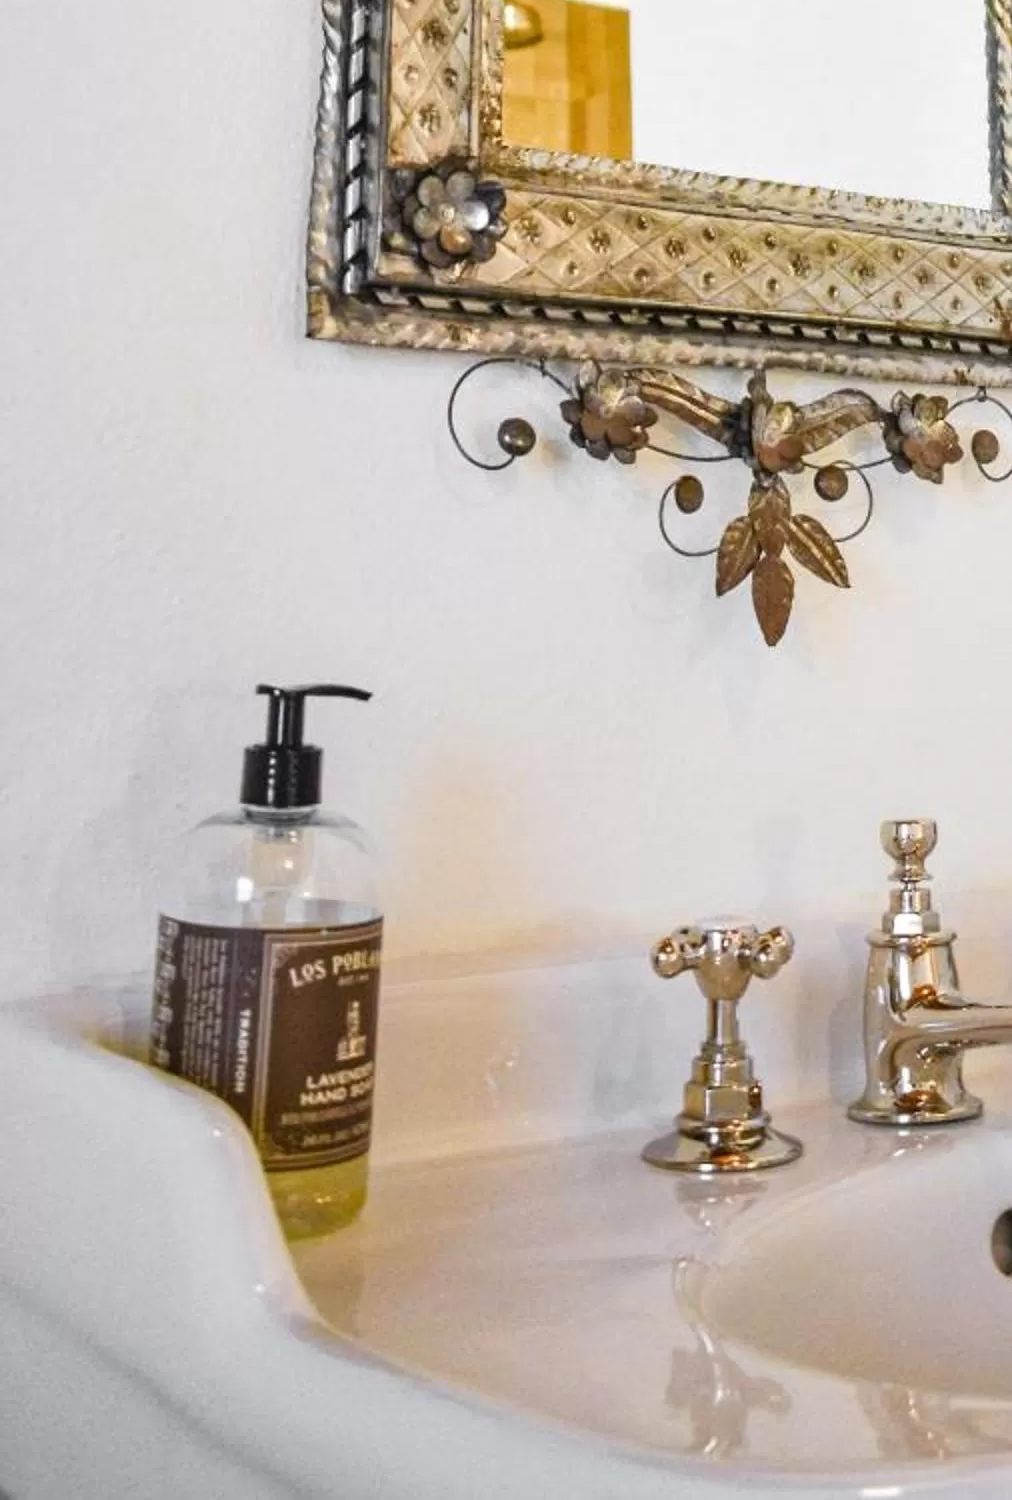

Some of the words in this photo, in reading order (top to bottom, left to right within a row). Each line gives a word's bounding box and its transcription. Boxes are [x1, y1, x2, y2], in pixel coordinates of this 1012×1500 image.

[289, 959, 327, 988] LOS
[234, 1008, 252, 1093] TRADITION
[300, 1086, 347, 1106] HAND
